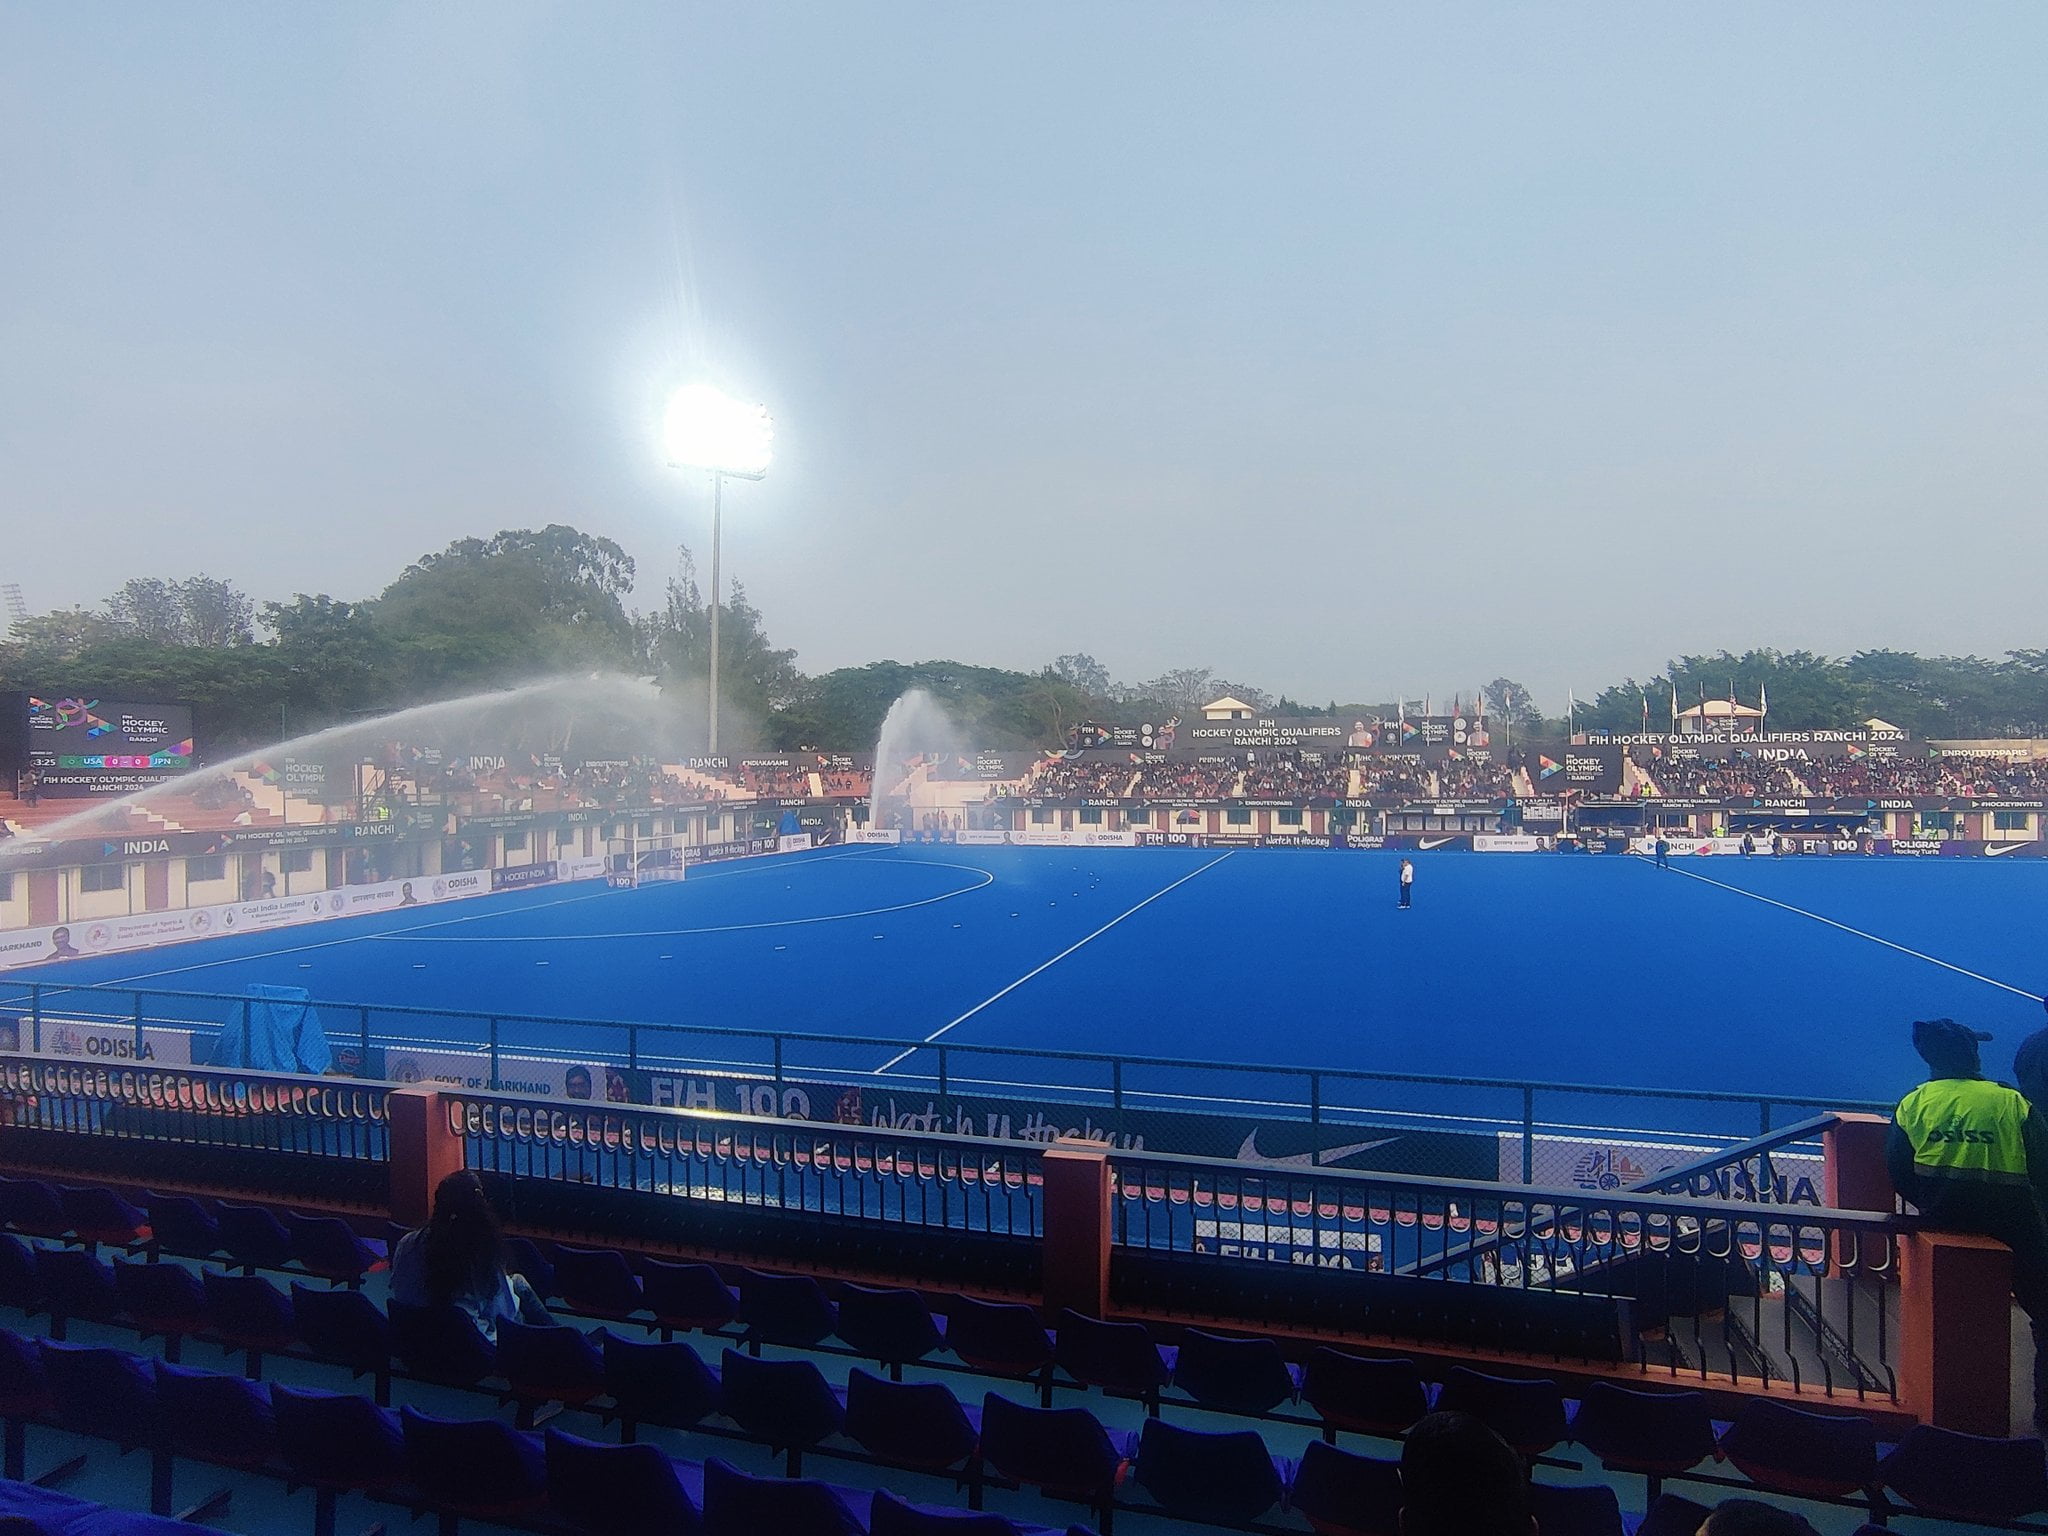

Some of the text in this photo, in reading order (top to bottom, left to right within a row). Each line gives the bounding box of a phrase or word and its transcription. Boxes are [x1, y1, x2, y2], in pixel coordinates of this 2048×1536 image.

[122, 719, 165, 727] HOCKEY
[1259, 719, 1276, 728] FIH
[122, 726, 169, 735] OLYMPIC
[1192, 727, 1341, 738] HOCKEY OLYMPIC QUALIFIERS
[1233, 737, 1299, 746] RANCHI 2024
[1589, 731, 1905, 745] FIH HOCKEY OLYMPIC QUALIFIERS RANCHI 2024
[1758, 748, 1809, 762] INDIA
[1941, 749, 2029, 757] ENROUTETOPARIS
[83, 757, 103, 765] USA
[111, 757, 119, 765] 0
[134, 757, 142, 765] 0
[153, 757, 171, 766] JPN
[470, 756, 506, 771] INDIA
[689, 757, 728, 769] RANCHI
[286, 764, 324, 773] HOCKEY
[43, 777, 59, 785] FIH
[60, 776, 97, 785] HOCKEY
[99, 775, 136, 784] OLYMPIC
[286, 773, 326, 782] OLYMPIC
[90, 784, 122, 792] RANCHI
[781, 798, 806, 807] RANCHI
[1088, 799, 1119, 807] RANCHI
[1345, 799, 1372, 808] INDIA
[1765, 799, 1806, 808] RANCHI
[1880, 800, 1914, 809] INDIA
[801, 817, 824, 826] INDIA
[354, 824, 395, 838] RANCHI
[1146, 834, 1187, 844] FIH 100
[1265, 836, 1330, 848] Watch Hockey
[1347, 835, 1385, 844] POLIGRAS
[124, 839, 170, 855] INDIA
[751, 838, 775, 851] FIH 100
[1832, 840, 1858, 851] 100
[1892, 840, 1940, 850] POLIGRAS
[1893, 848, 1920, 857] Hockey
[504, 869, 547, 883] HOCKEY INDIA
[448, 876, 479, 889] ODISHA
[616, 877, 631, 887] 100
[242, 900, 305, 914] Coal India Limited
[86, 1035, 155, 1061] ODISHA
[467, 1078, 482, 1089] OF
[650, 1076, 811, 1122] FIH 100
